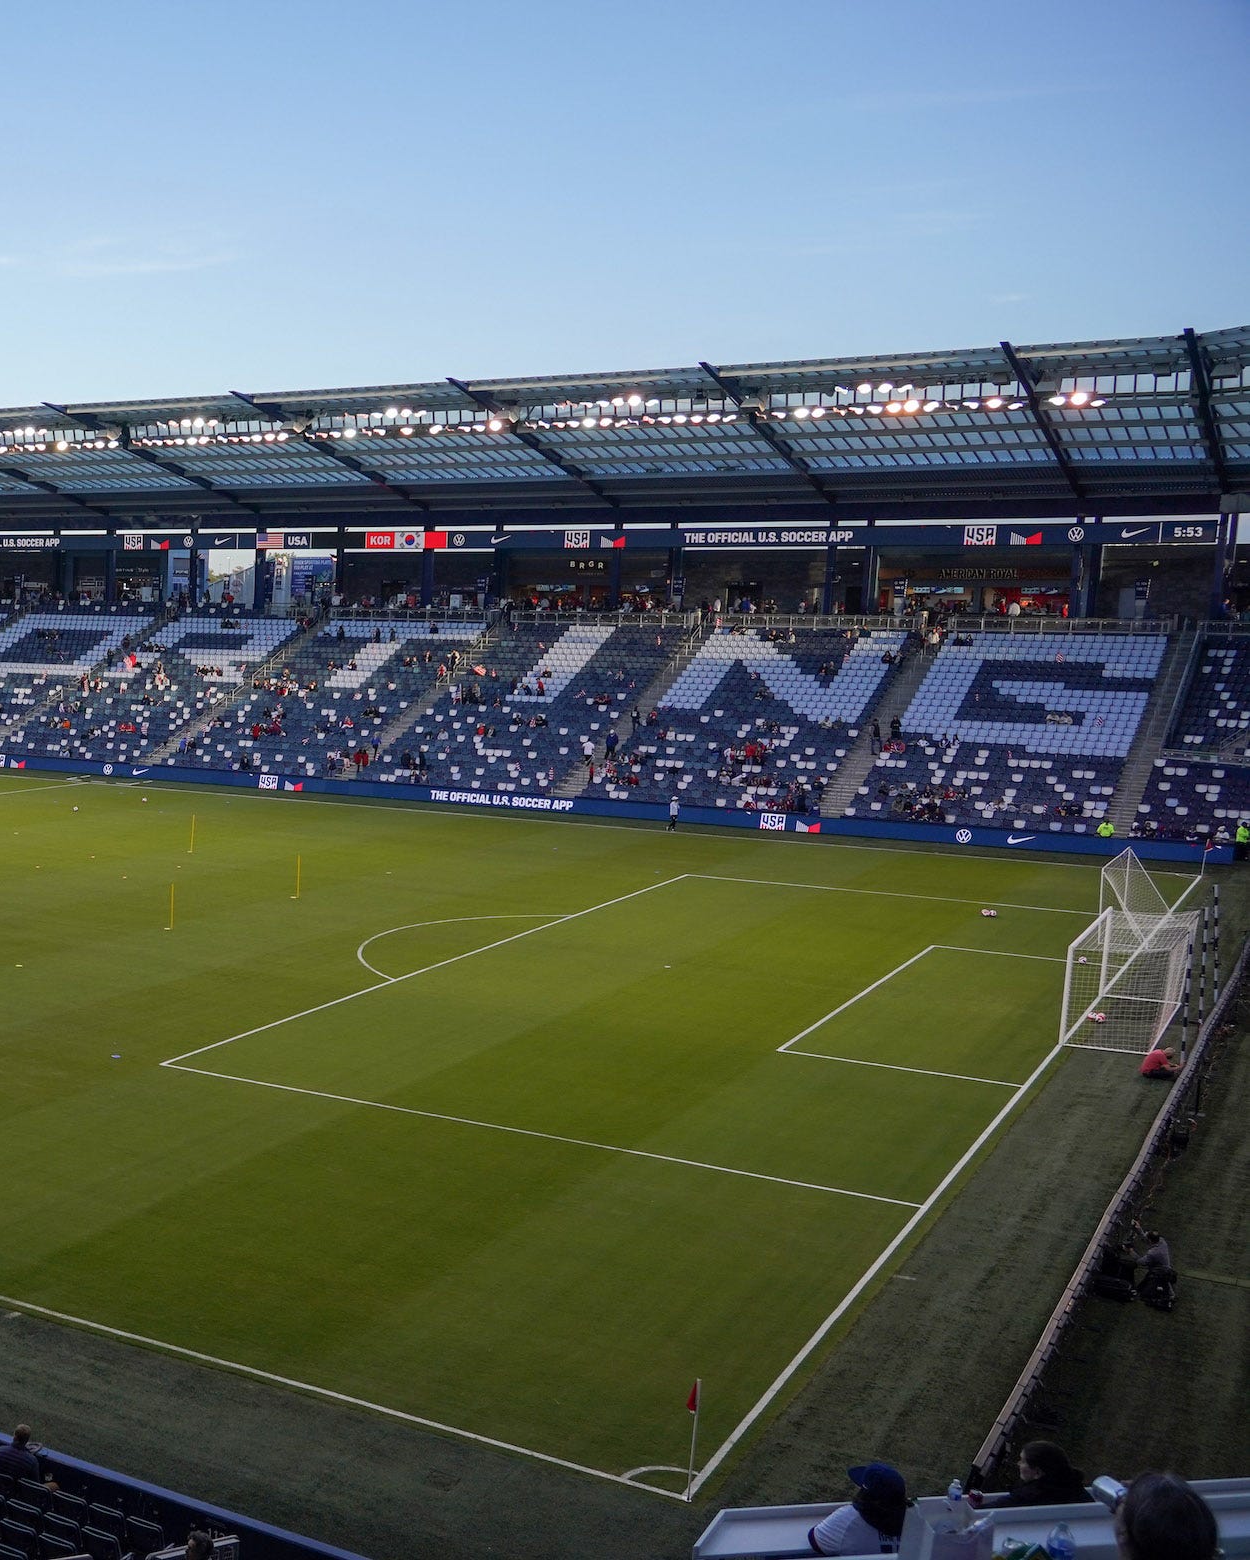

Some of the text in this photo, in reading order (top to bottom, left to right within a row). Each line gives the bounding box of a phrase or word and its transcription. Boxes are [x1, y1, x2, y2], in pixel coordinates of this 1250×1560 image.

[565, 531, 589, 545] USA
[684, 531, 853, 543] THE OFFICIAL U.S. SOCCER APP
[966, 527, 994, 542] USA
[1173, 526, 1203, 538] 5:53
[2, 538, 16, 547] U.S.
[16, 538, 44, 547] SOCCER
[45, 538, 60, 547] APP
[125, 535, 143, 547] USA
[287, 536, 308, 546] USA
[370, 535, 391, 546] KOR
[939, 568, 1018, 579] AMERICAN ROYAL
[260, 775, 278, 787] USA
[430, 790, 574, 811] THE OFFICIAL U.S. SOCCER APP
[761, 813, 785, 828] USA
